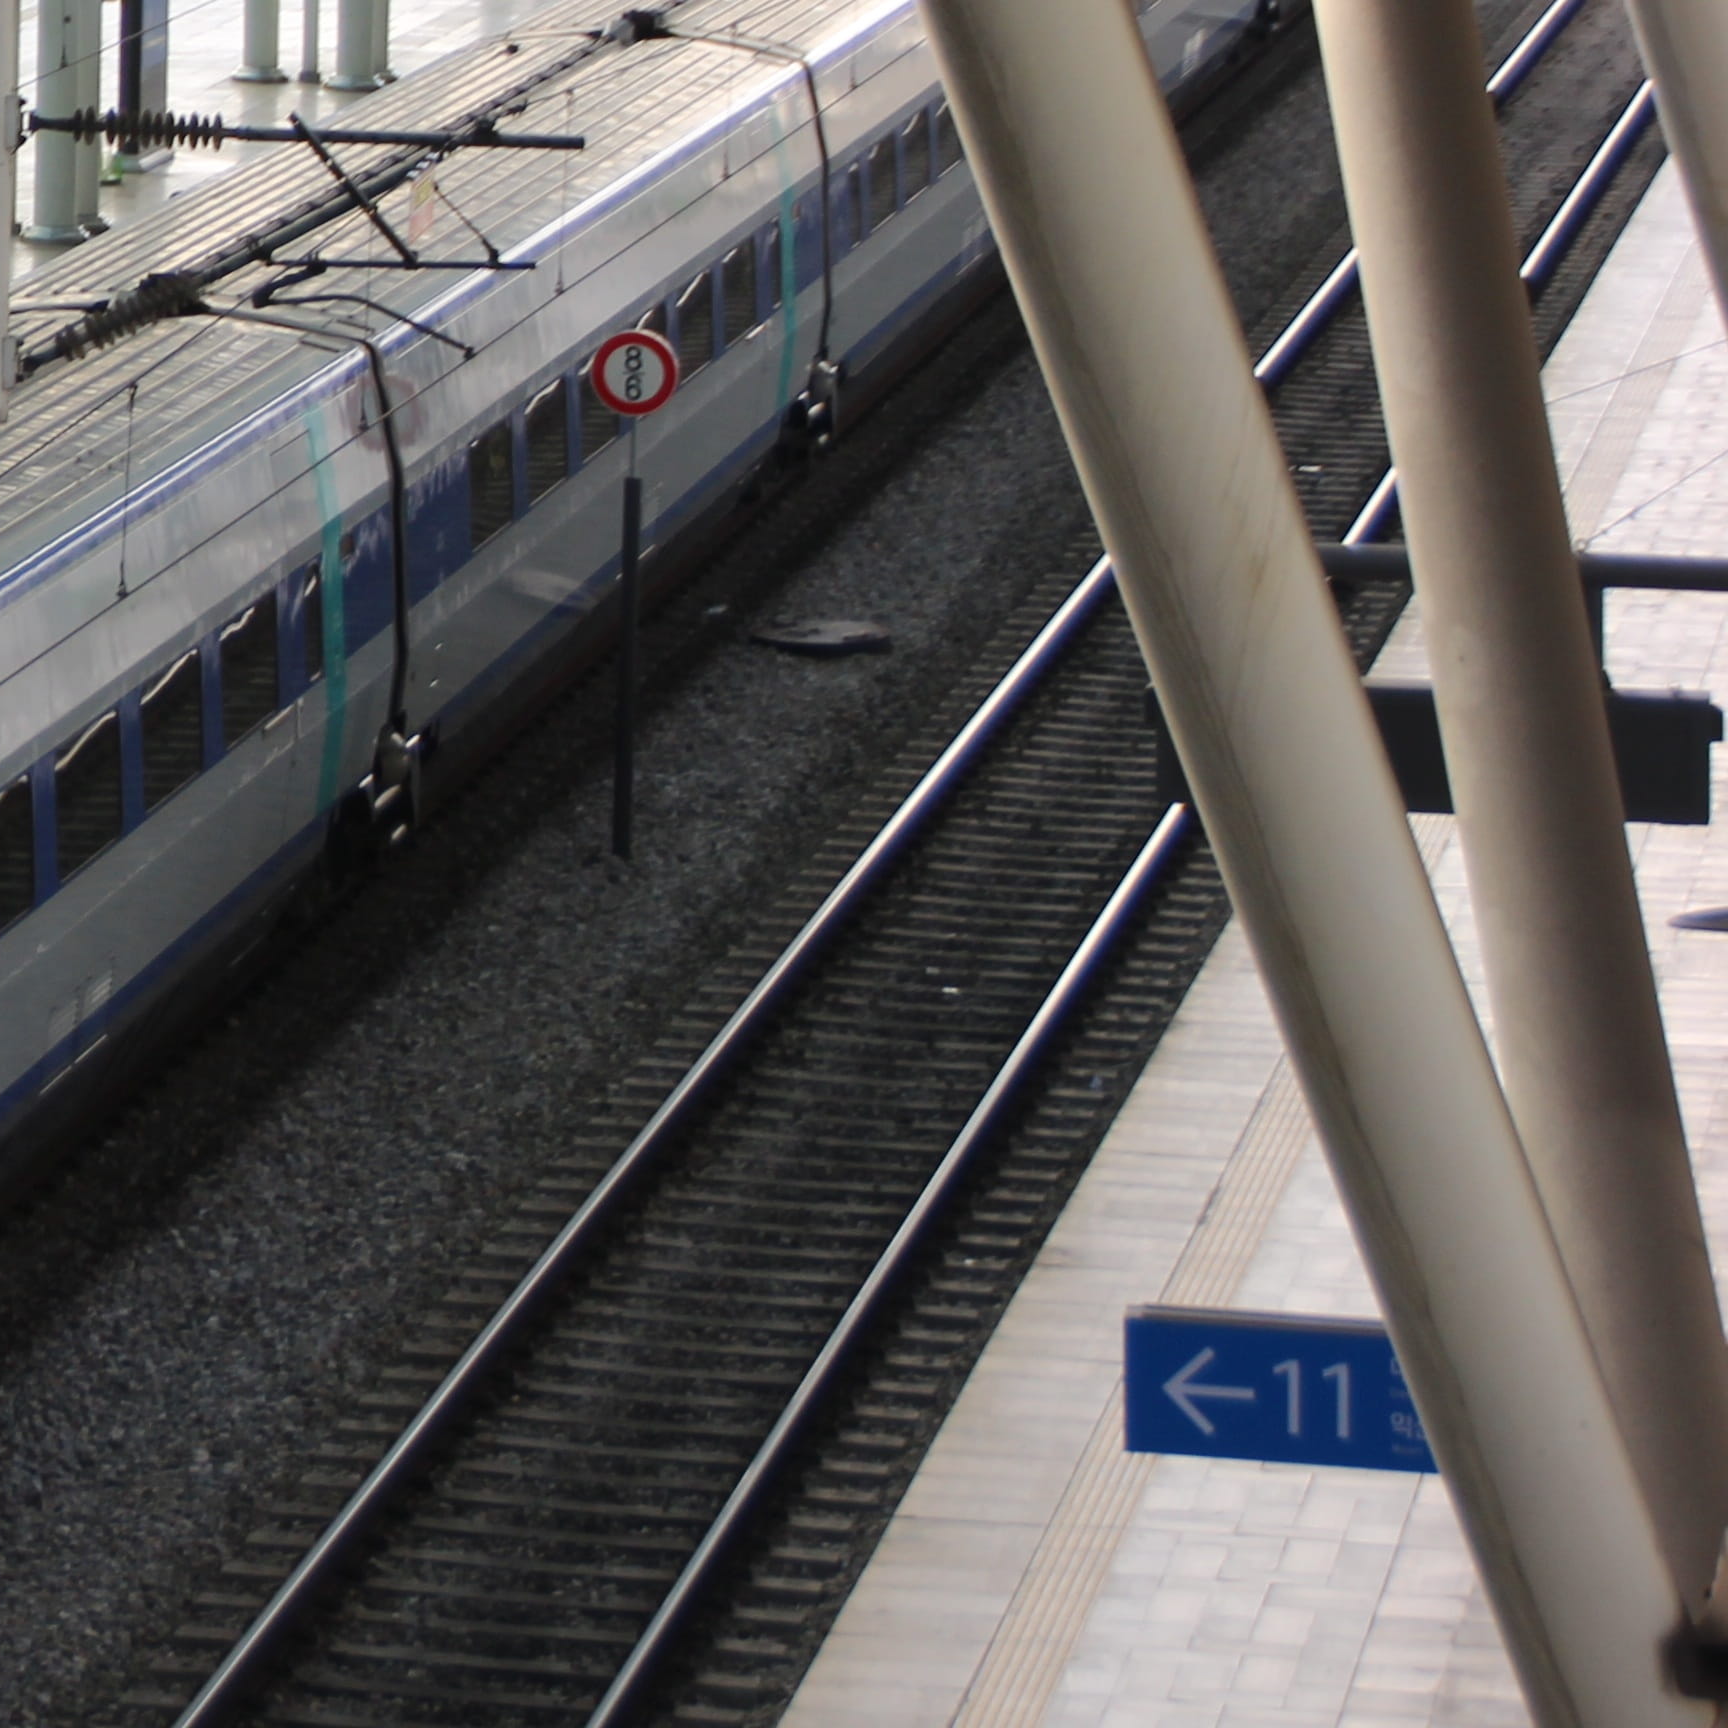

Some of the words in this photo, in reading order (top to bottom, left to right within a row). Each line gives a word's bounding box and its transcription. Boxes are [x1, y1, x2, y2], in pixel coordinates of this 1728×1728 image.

[625, 346, 642, 372] 8
[625, 375, 642, 401] 6
[1272, 1358, 1352, 1439] 11
